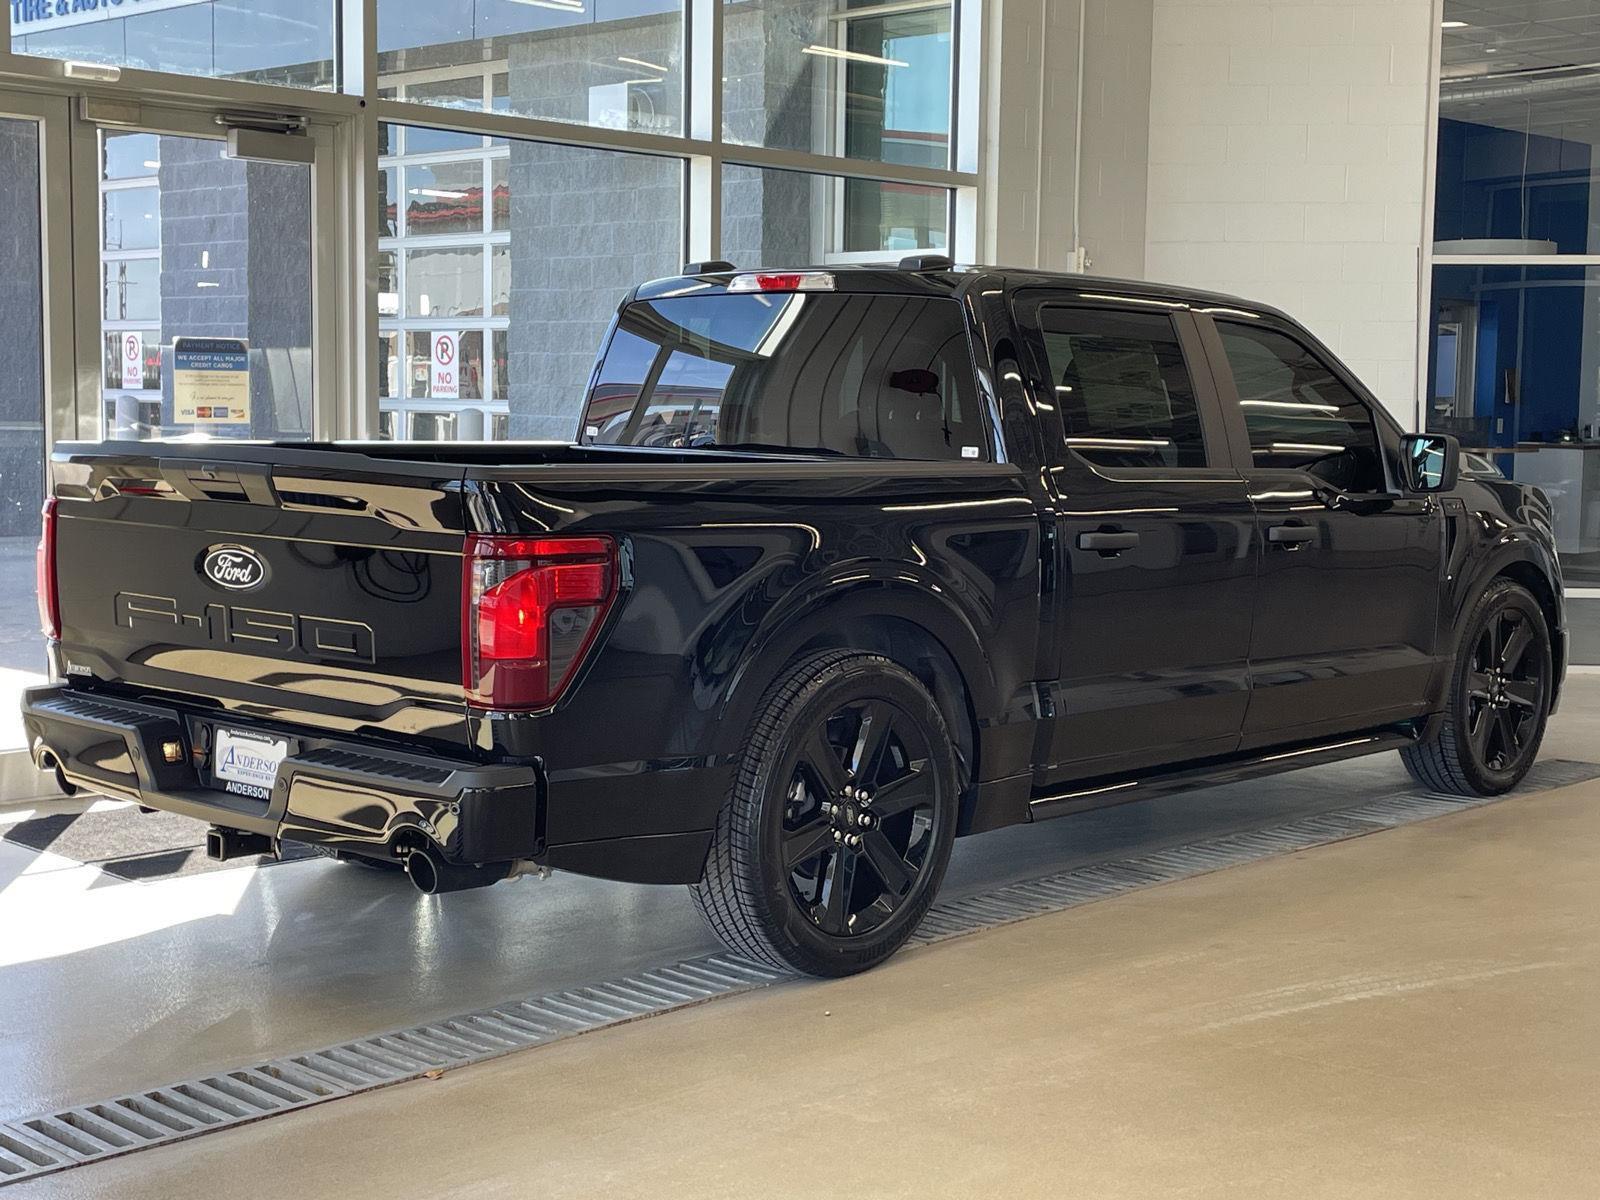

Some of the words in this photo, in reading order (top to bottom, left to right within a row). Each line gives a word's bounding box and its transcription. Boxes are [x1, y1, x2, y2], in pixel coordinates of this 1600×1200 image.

[127, 366, 138, 377] NO
[438, 373, 452, 384] NO
[432, 385, 458, 393] PARKING
[214, 554, 252, 582] Ford
[115, 592, 376, 664] F-150
[226, 781, 269, 799] ANDERSON
